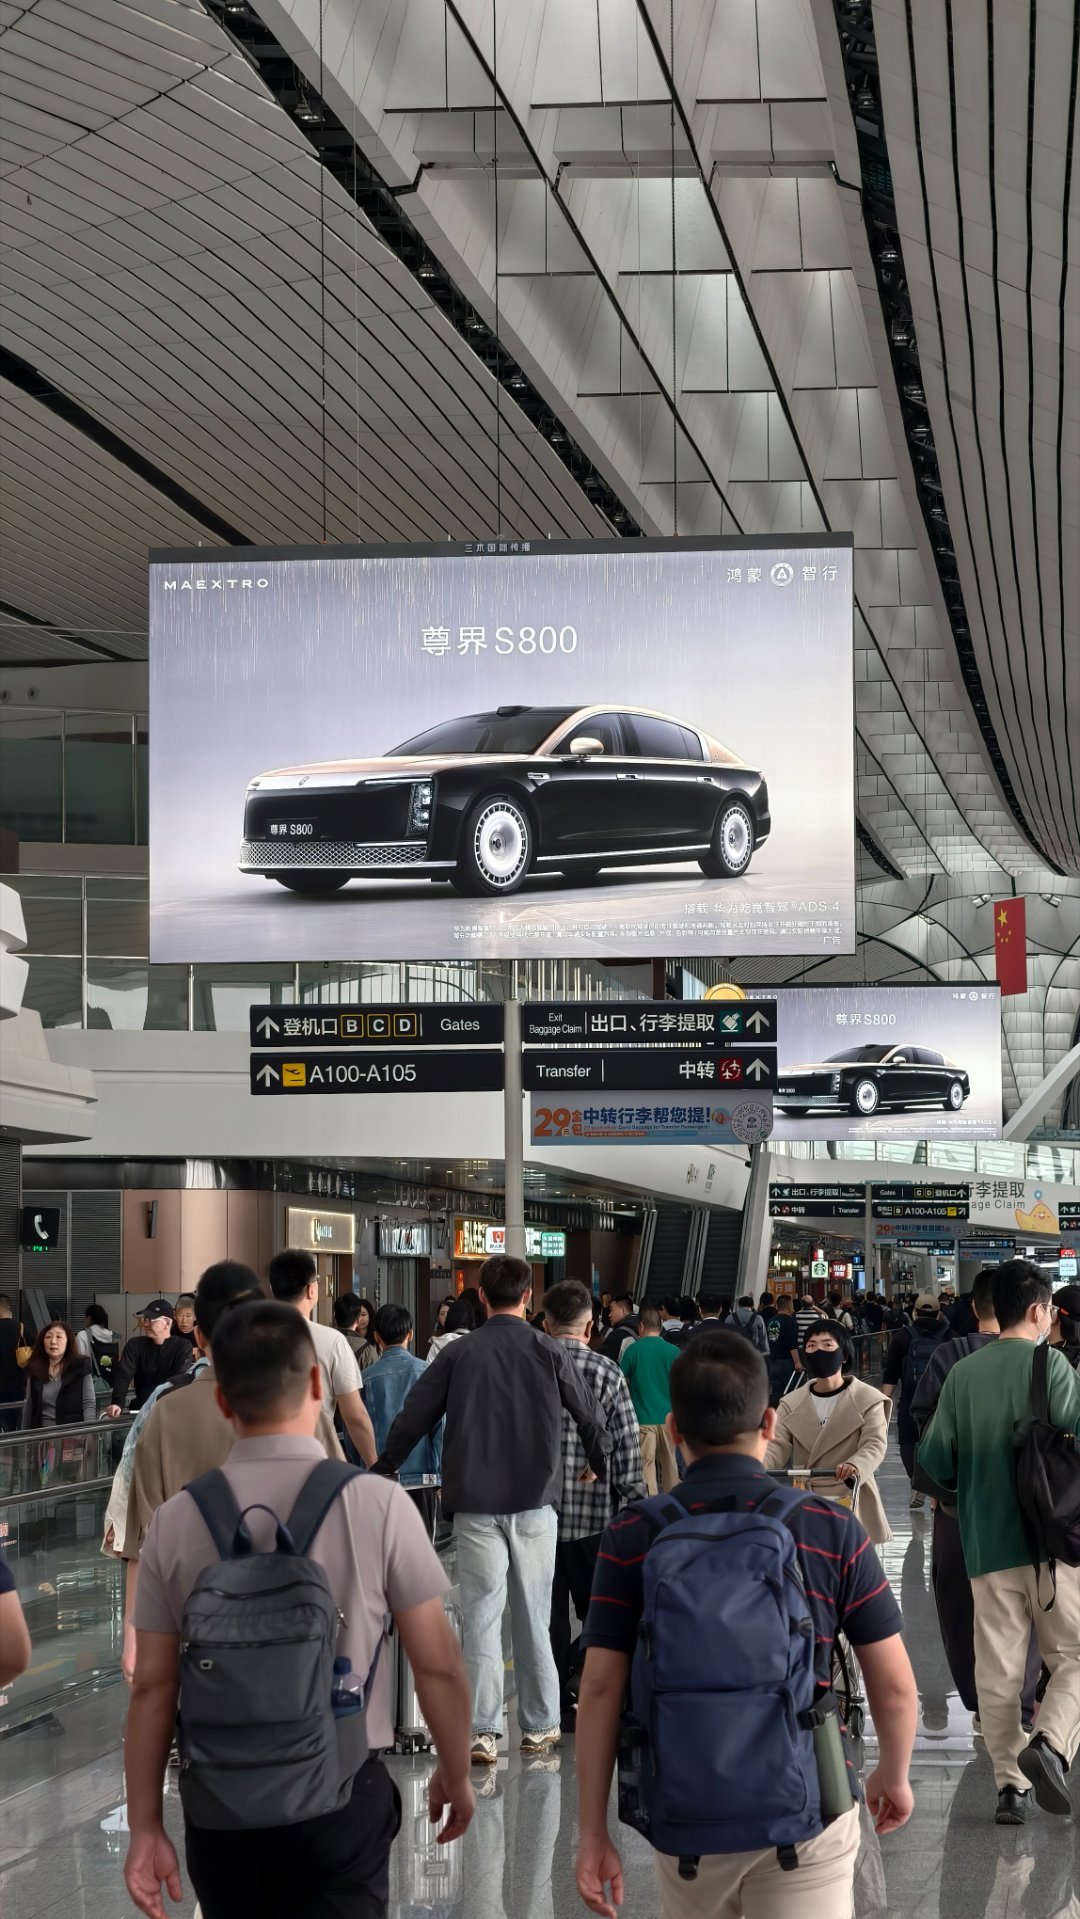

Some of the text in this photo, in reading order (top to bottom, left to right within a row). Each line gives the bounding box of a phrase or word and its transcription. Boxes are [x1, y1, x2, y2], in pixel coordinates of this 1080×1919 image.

[727, 566, 837, 583] 鸿蒙 智行
[164, 579, 269, 590] MAEXTRO
[290, 823, 313, 835] S800
[822, 936, 841, 945] 广告
[548, 1012, 563, 1022] Exit
[591, 1013, 715, 1032] 出口、行李提取
[283, 1018, 481, 1036] 登机口 B C D Gates
[529, 1024, 582, 1036] Baggage Claim
[309, 1063, 417, 1083] A100-A105
[536, 1064, 591, 1077] Transfer
[679, 1061, 715, 1080] 中转
[533, 1107, 571, 1137] 29
[994, 1199, 1026, 1209] Claim
[905, 1207, 947, 1216] A100-A105
